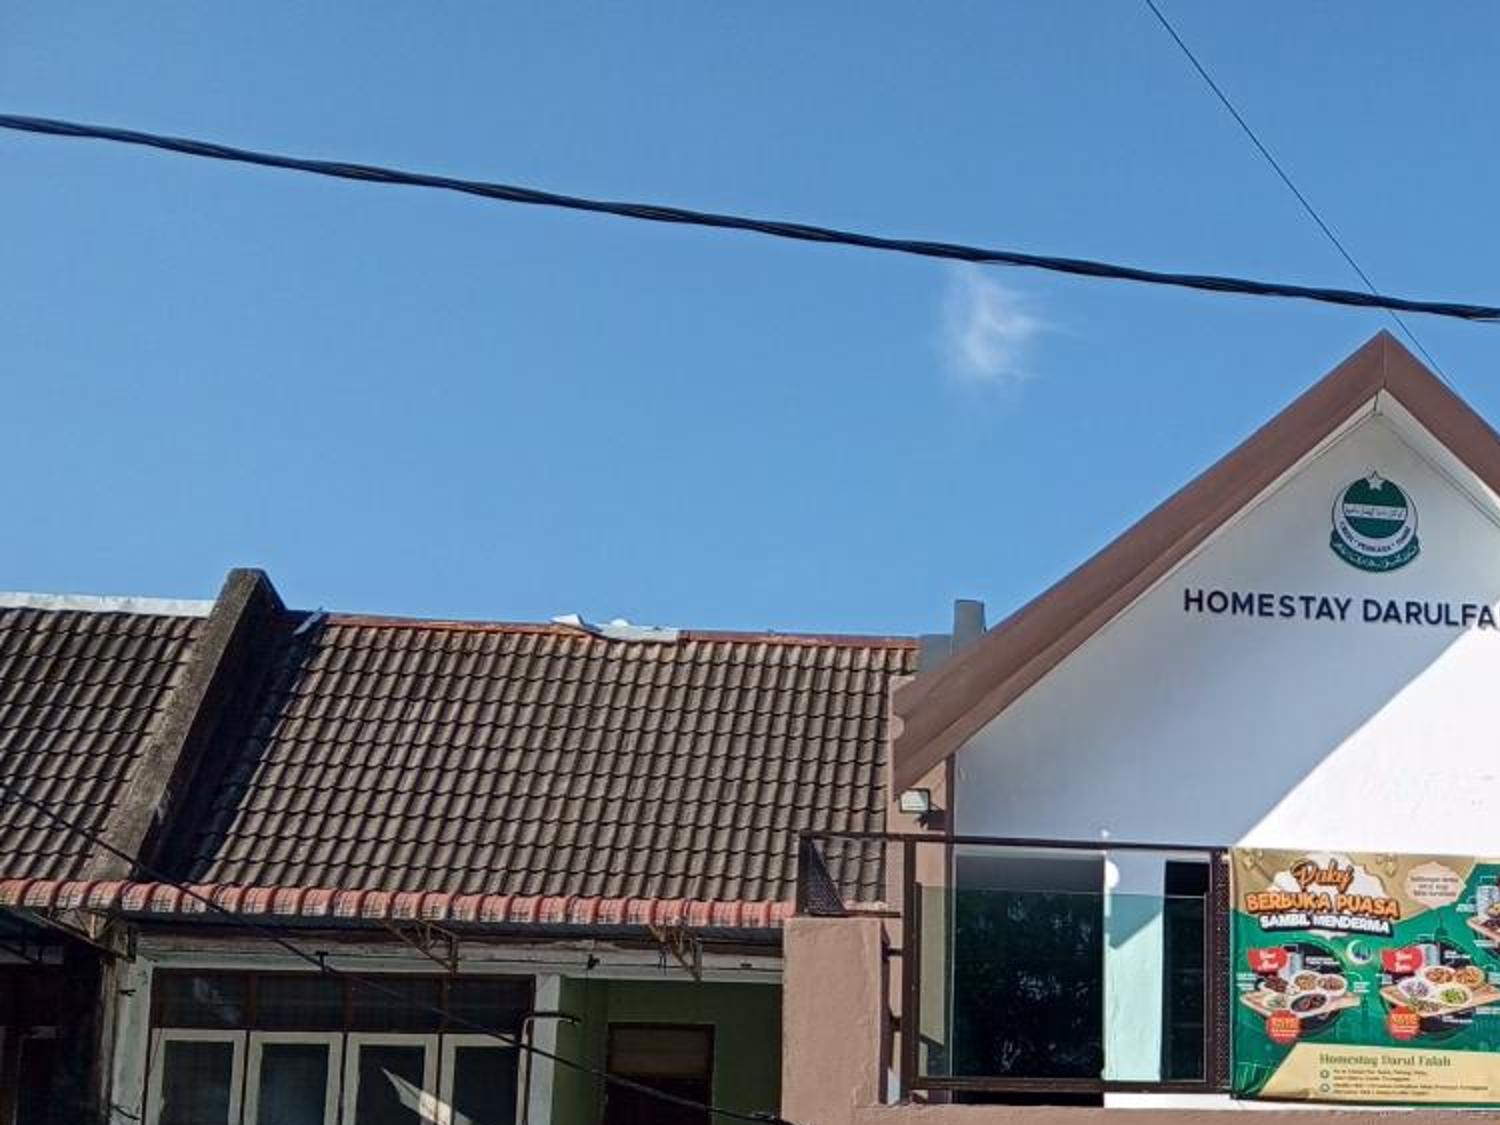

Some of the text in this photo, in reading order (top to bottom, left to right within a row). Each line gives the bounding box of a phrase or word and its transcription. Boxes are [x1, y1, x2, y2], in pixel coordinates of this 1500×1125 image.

[1183, 588, 1352, 622] HOMESTAY
[1247, 891, 1399, 918] BERBUKA PUASA
[1260, 913, 1391, 933] SAMBIL MENDERMA
[1319, 1053, 1451, 1067] Homestay Darul Falah
